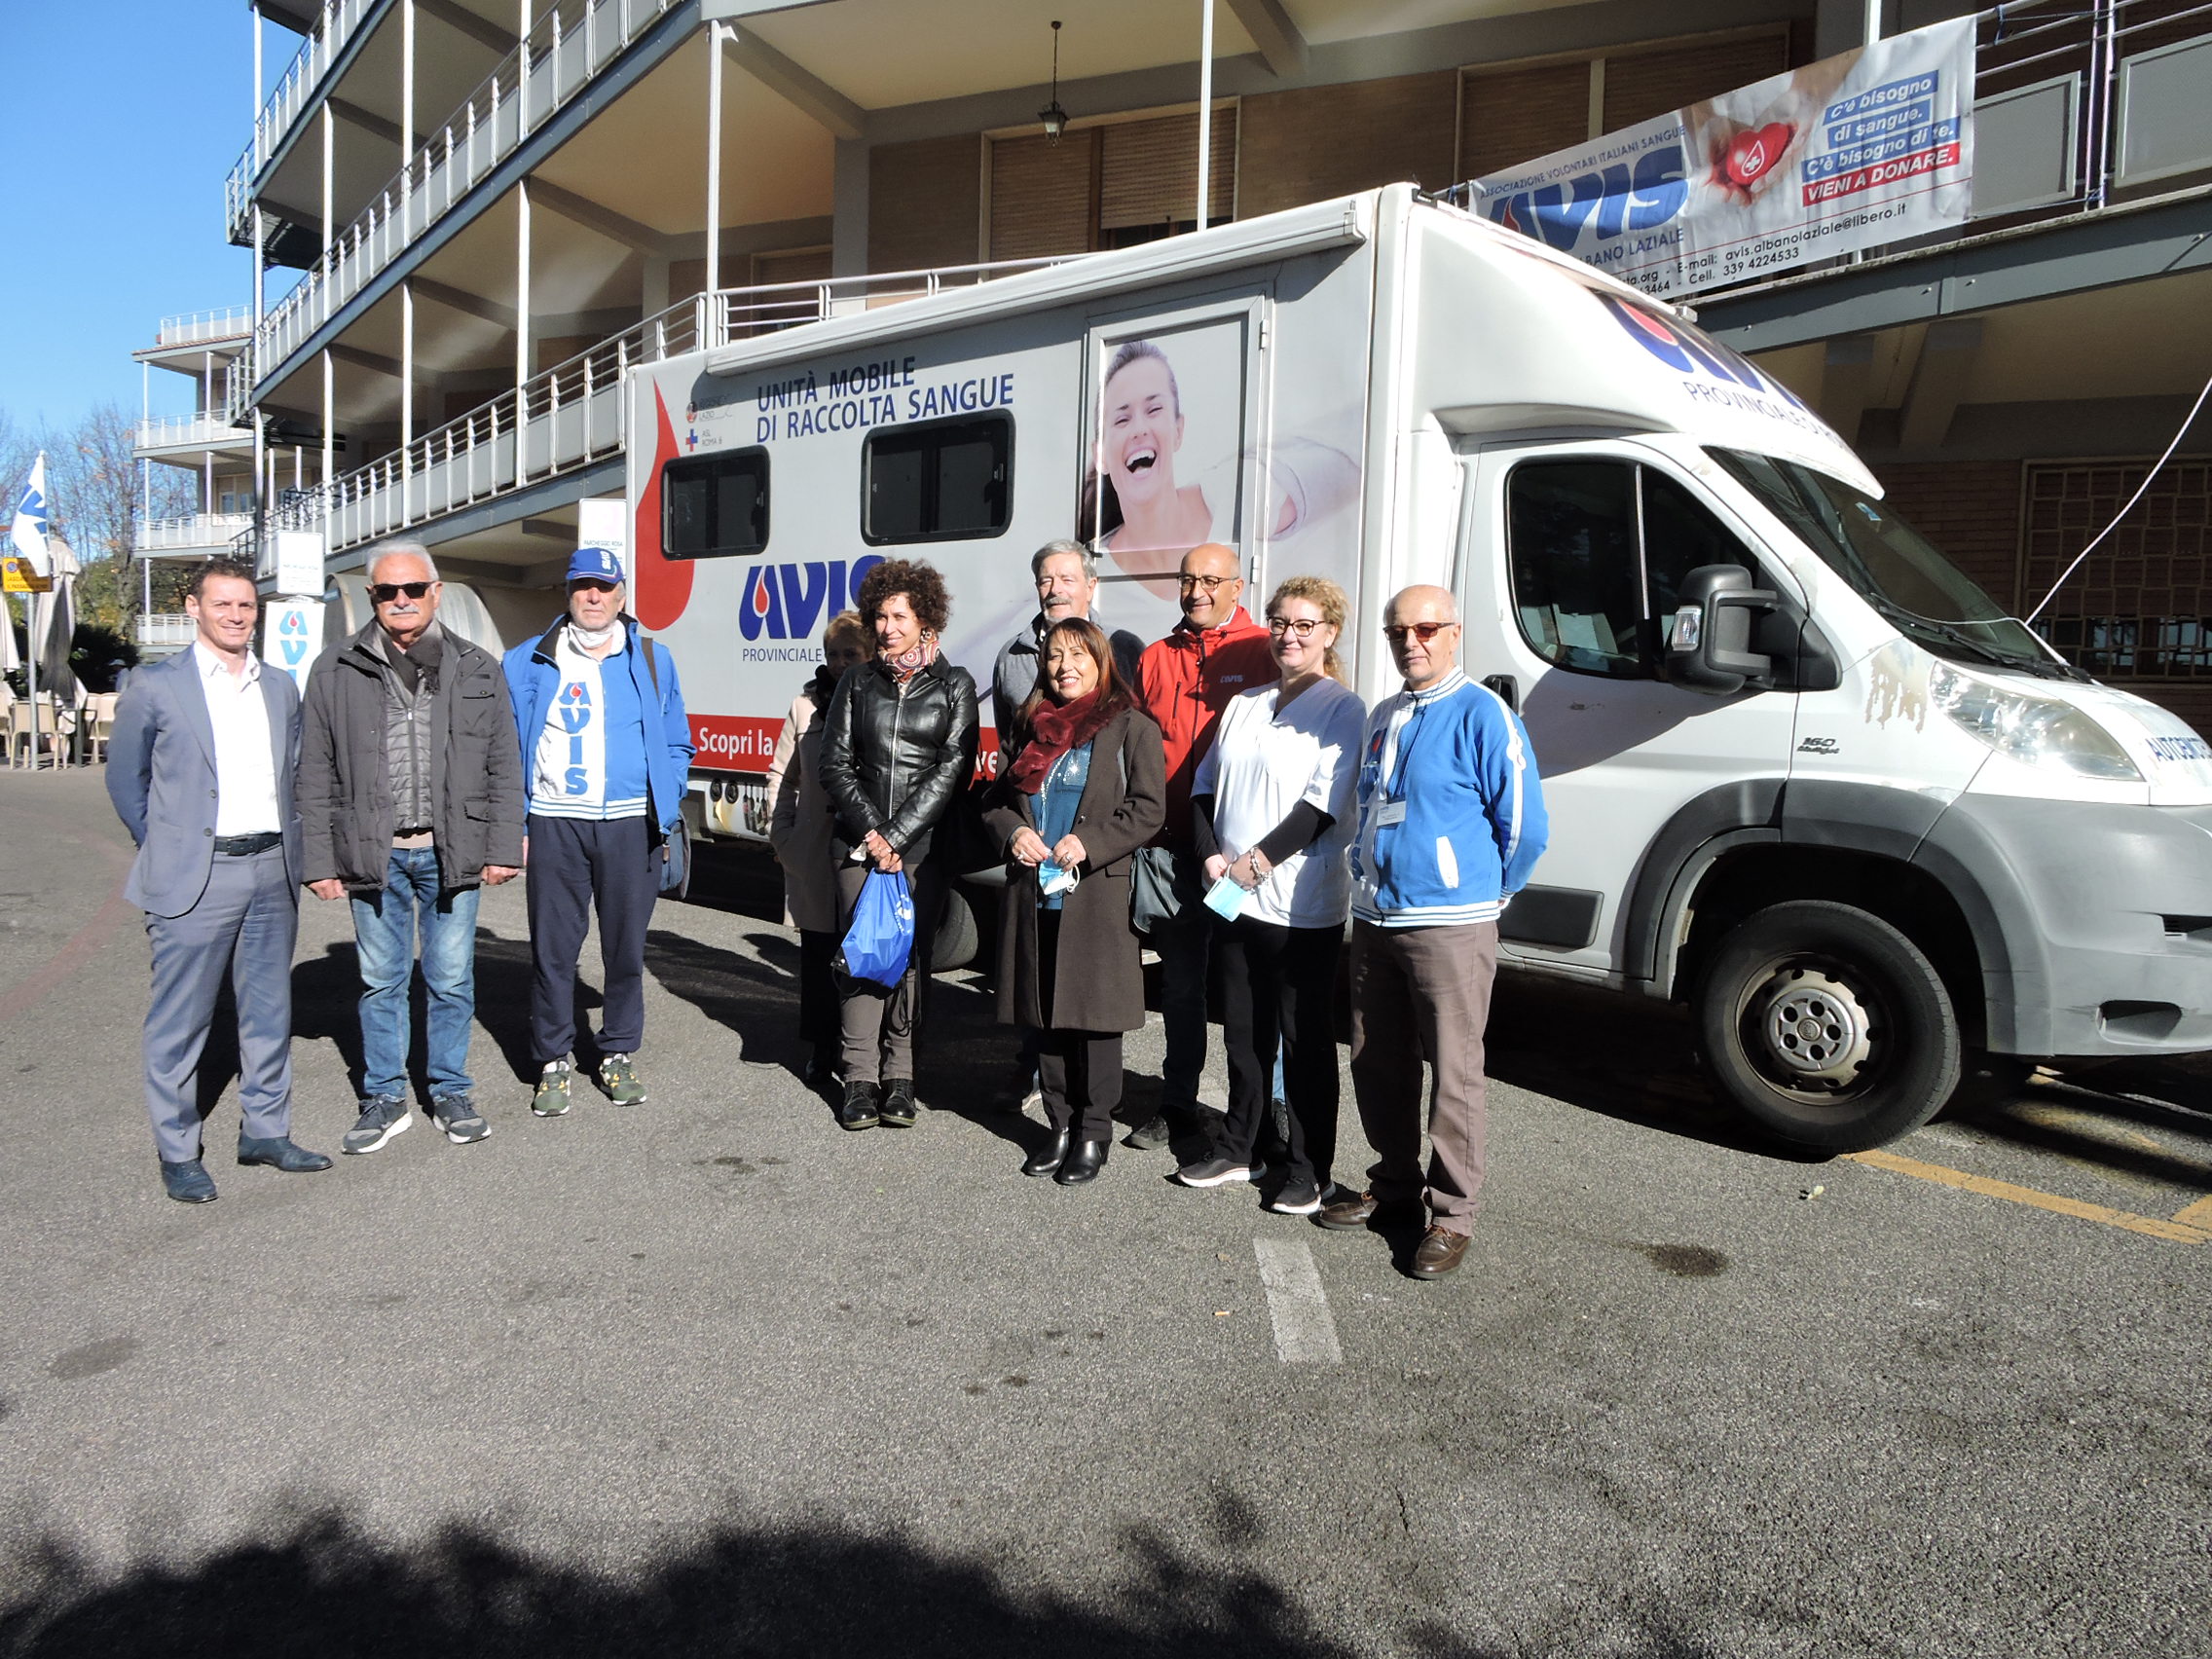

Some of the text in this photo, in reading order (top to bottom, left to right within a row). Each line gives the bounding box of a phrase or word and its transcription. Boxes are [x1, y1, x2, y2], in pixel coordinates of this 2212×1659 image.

[1830, 77, 1932, 119] C'è bisogno
[1834, 107, 1923, 142] di sangue.
[1480, 125, 1686, 200] ASSOCIAZIONE VOLONTARI ITALIANI SANGUE
[1806, 122, 1954, 176] C'è bisogno di te.
[1808, 148, 1954, 202] VIENI A DONARE.
[1489, 145, 1689, 250] AVIS
[1629, 227, 1684, 255] LAZIALE
[1677, 254, 1718, 274] E-mail:
[1725, 203, 1906, 261] avis.albanolaziale@libero.it
[1689, 269, 1715, 284] Cell.
[1723, 261, 1745, 276] 339
[1748, 247, 1799, 269] 4224533
[756, 373, 1014, 443] DI RACCOLTA SANGUE
[757, 355, 916, 413] UNITÀ MOBILE
[742, 647, 823, 662] PROVINCIALE
[558, 682, 592, 795] AVIS
[699, 726, 753, 759] Scopri
[757, 734, 773, 756] la
[1802, 737, 1836, 747] 160
